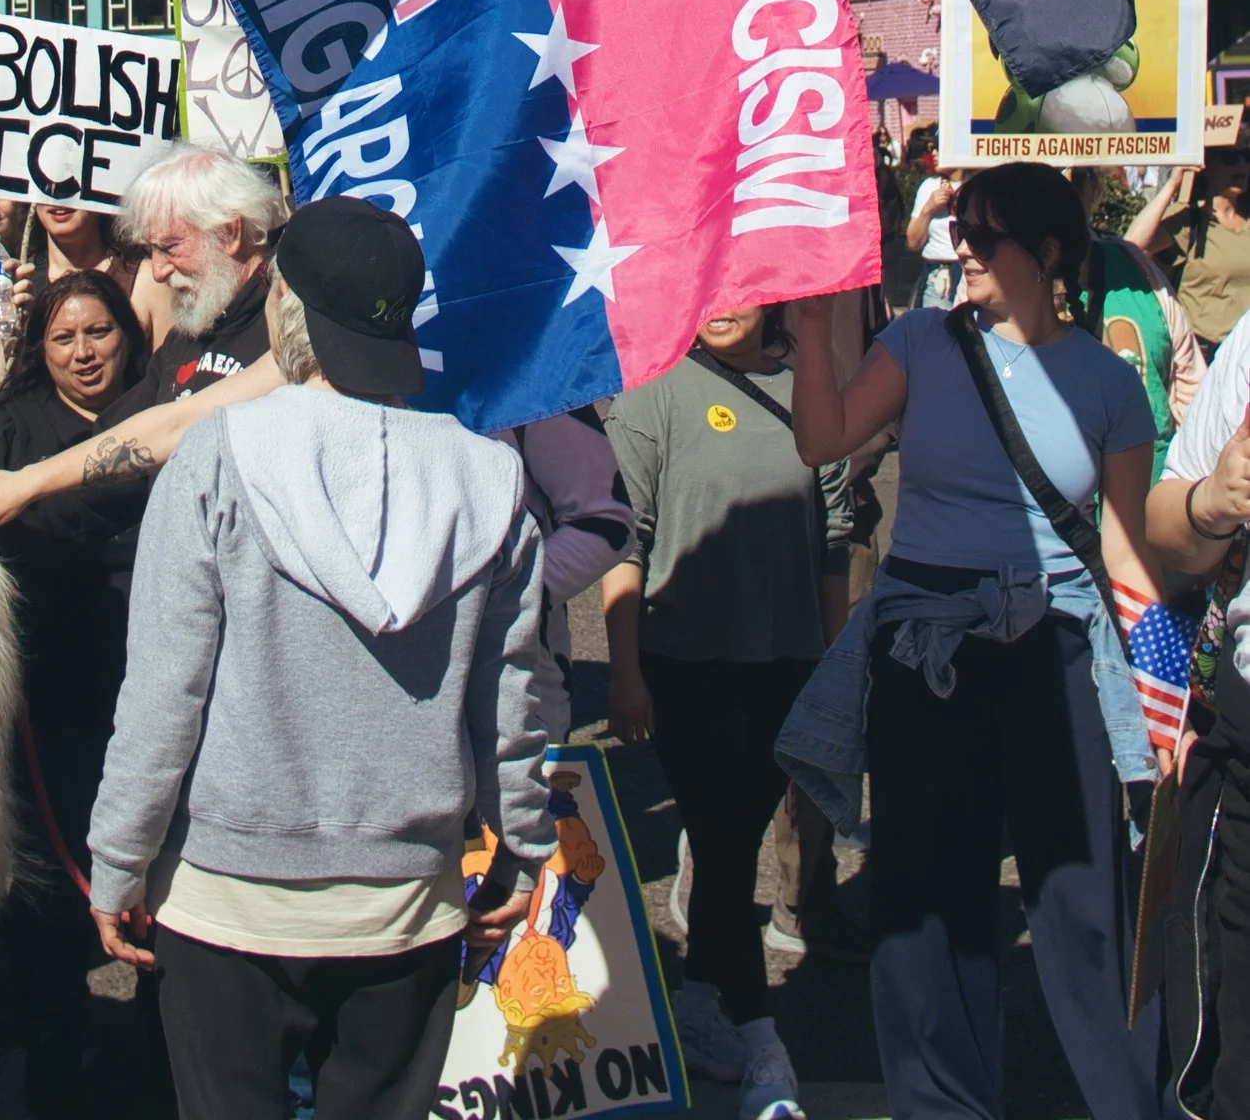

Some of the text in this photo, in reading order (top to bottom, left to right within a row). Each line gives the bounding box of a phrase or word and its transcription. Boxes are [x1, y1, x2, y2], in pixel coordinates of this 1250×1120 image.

[1204, 115, 1234, 131] NGS
[975, 136, 1170, 156] FIGHTS AGAINST FASCISM
[430, 1042, 668, 1120] NO KINGS
